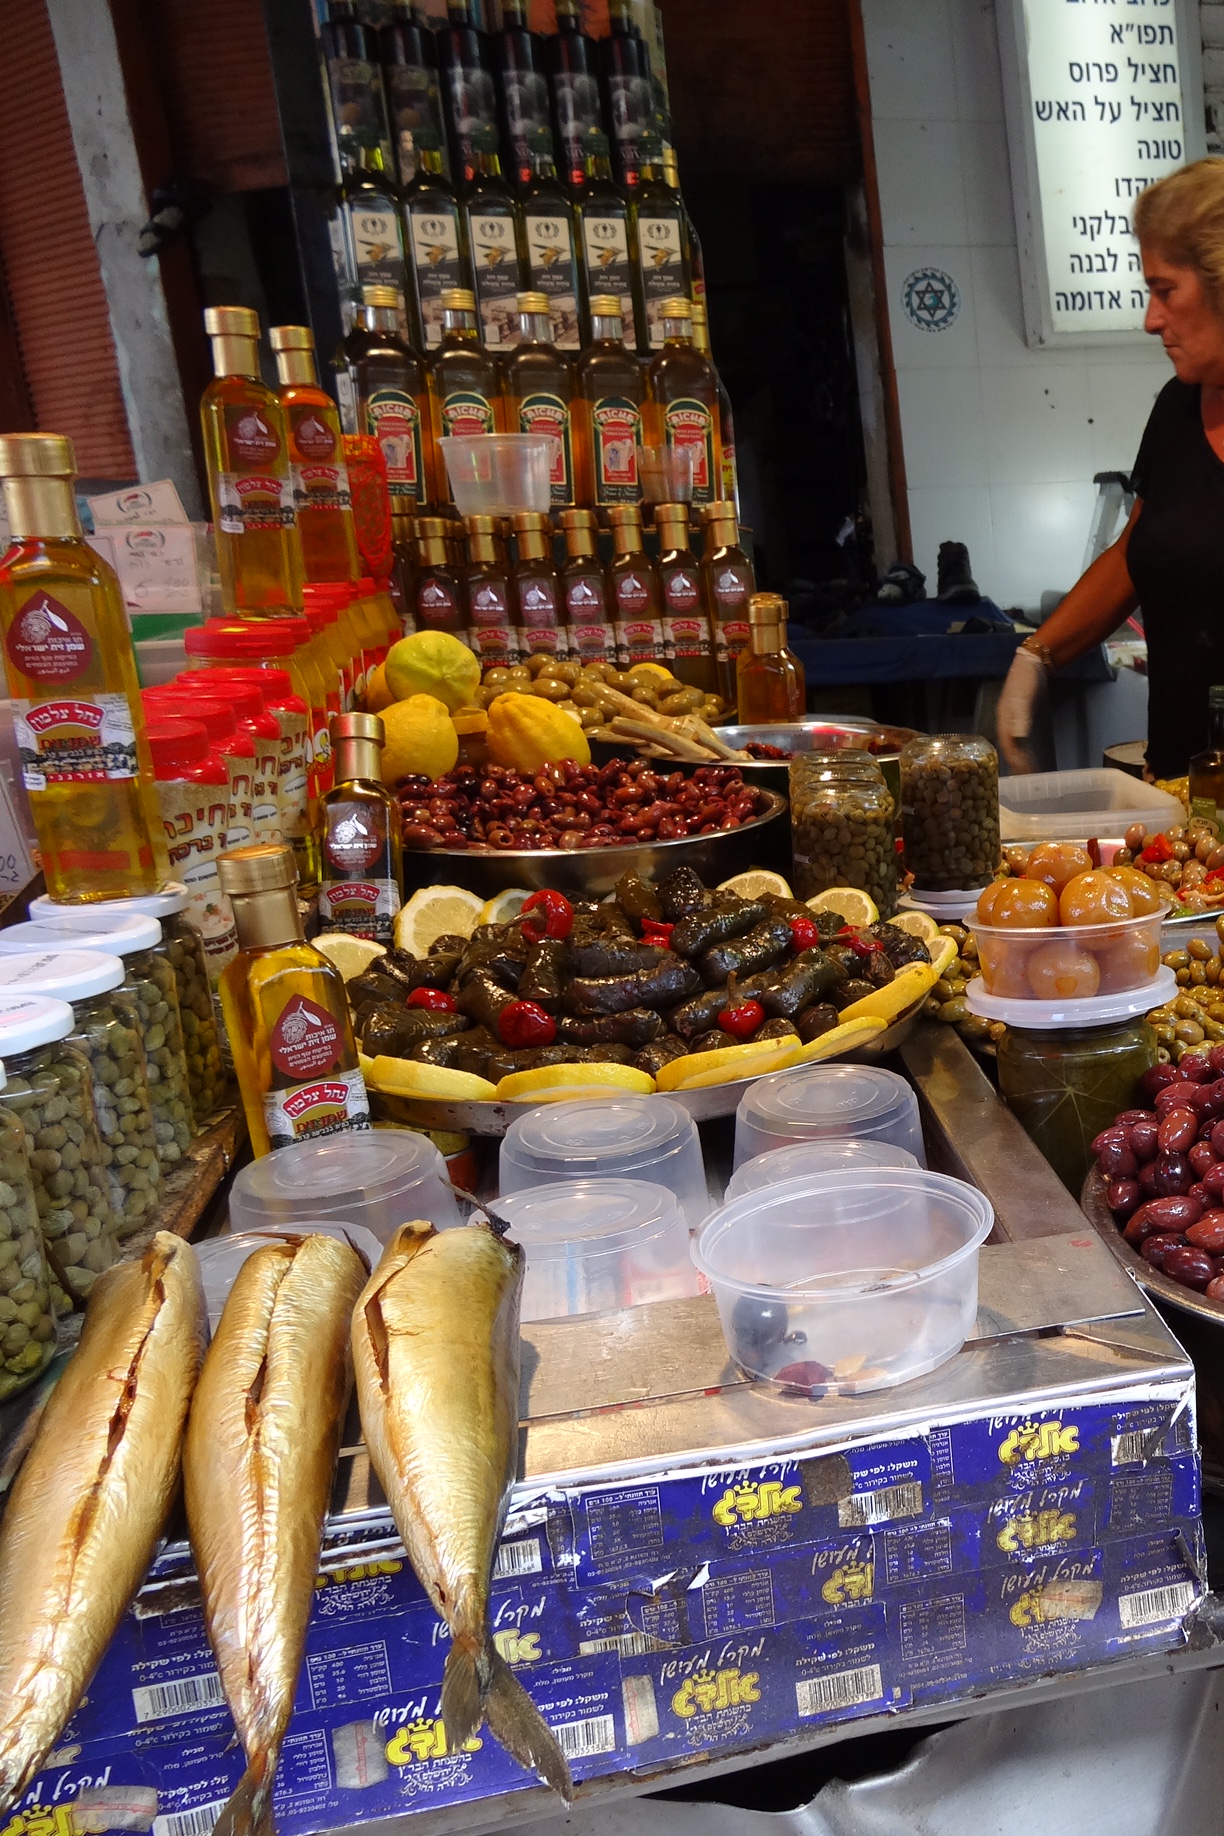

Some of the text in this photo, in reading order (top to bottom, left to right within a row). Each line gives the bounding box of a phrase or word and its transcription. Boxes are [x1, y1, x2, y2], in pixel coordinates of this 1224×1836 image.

[1069, 57, 1177, 84] חציל פרוס
[1036, 96, 1179, 124] חציל על האש
[1138, 139, 1182, 160] טונה
[1073, 211, 1131, 241] בלקני
[1070, 248, 1118, 274] לבנה
[1055, 289, 1122, 312] אדומה
[30, 704, 100, 730] נחל צלמון
[329, 885, 378, 903] נחל צלמון
[278, 1033, 337, 1054] שמן זית ישראלי
[305, 1029, 325, 1041] איכות
[286, 1084, 346, 1116] נחל צלמון
[870, 1459, 918, 1474] משקל: לפי
[1039, 1480, 1083, 1507] מקרל
[988, 1491, 1034, 1524] מעושן
[1001, 1558, 1094, 1599] מקרל מעושן
[494, 1596, 546, 1627] מקרל
[579, 1613, 613, 1628] שקילה
[321, 1651, 335, 1660] 100
[369, 1641, 384, 1650] ערך
[131, 1653, 191, 1672] לפי שקילה
[165, 1664, 196, 1678] בקירור
[332, 1660, 344, 1668] 400
[660, 1637, 766, 1685] מקרל מעושן
[156, 1703, 193, 1716] 290002
[555, 1691, 608, 1709] משקל: לפי
[579, 1703, 604, 1715] לשמור
[373, 1696, 427, 1731] מעושן
